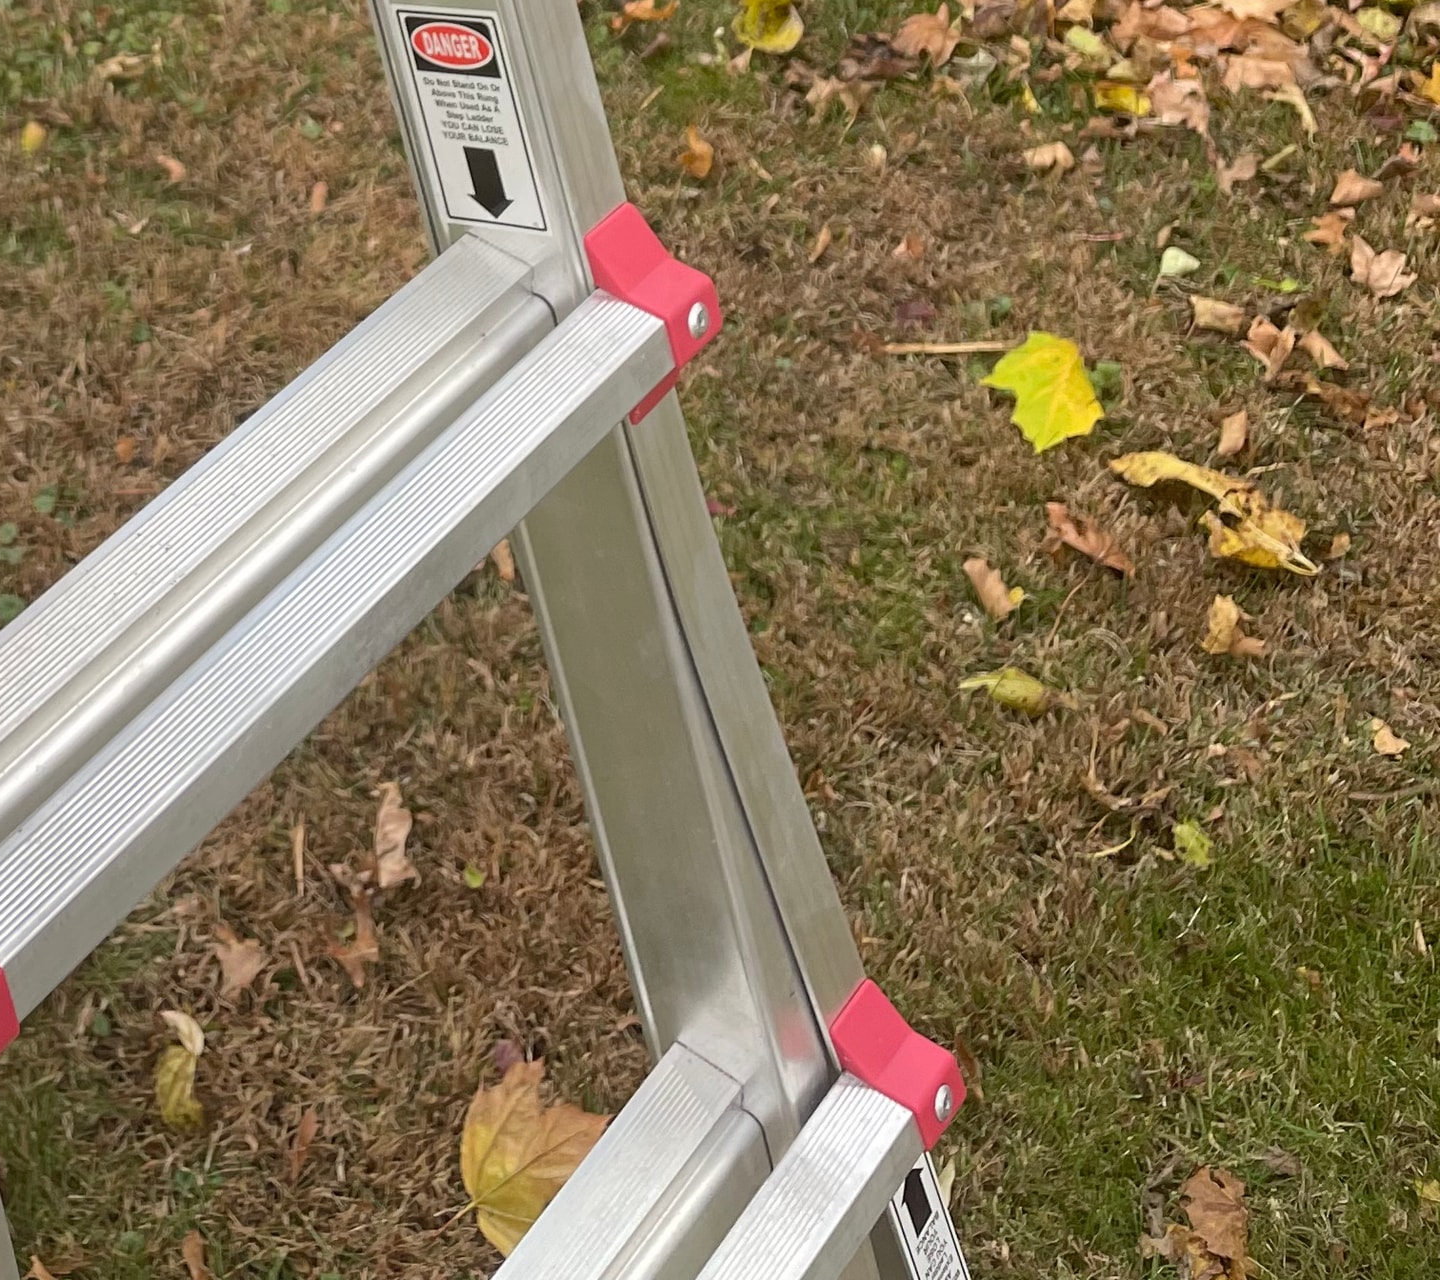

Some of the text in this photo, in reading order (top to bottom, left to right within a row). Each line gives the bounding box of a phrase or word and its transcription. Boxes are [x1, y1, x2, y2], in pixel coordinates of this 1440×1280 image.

[421, 31, 483, 60] DANGER
[441, 120, 504, 134] YOU CAN LOSE
[442, 131, 509, 145] YOUR BALANCE
